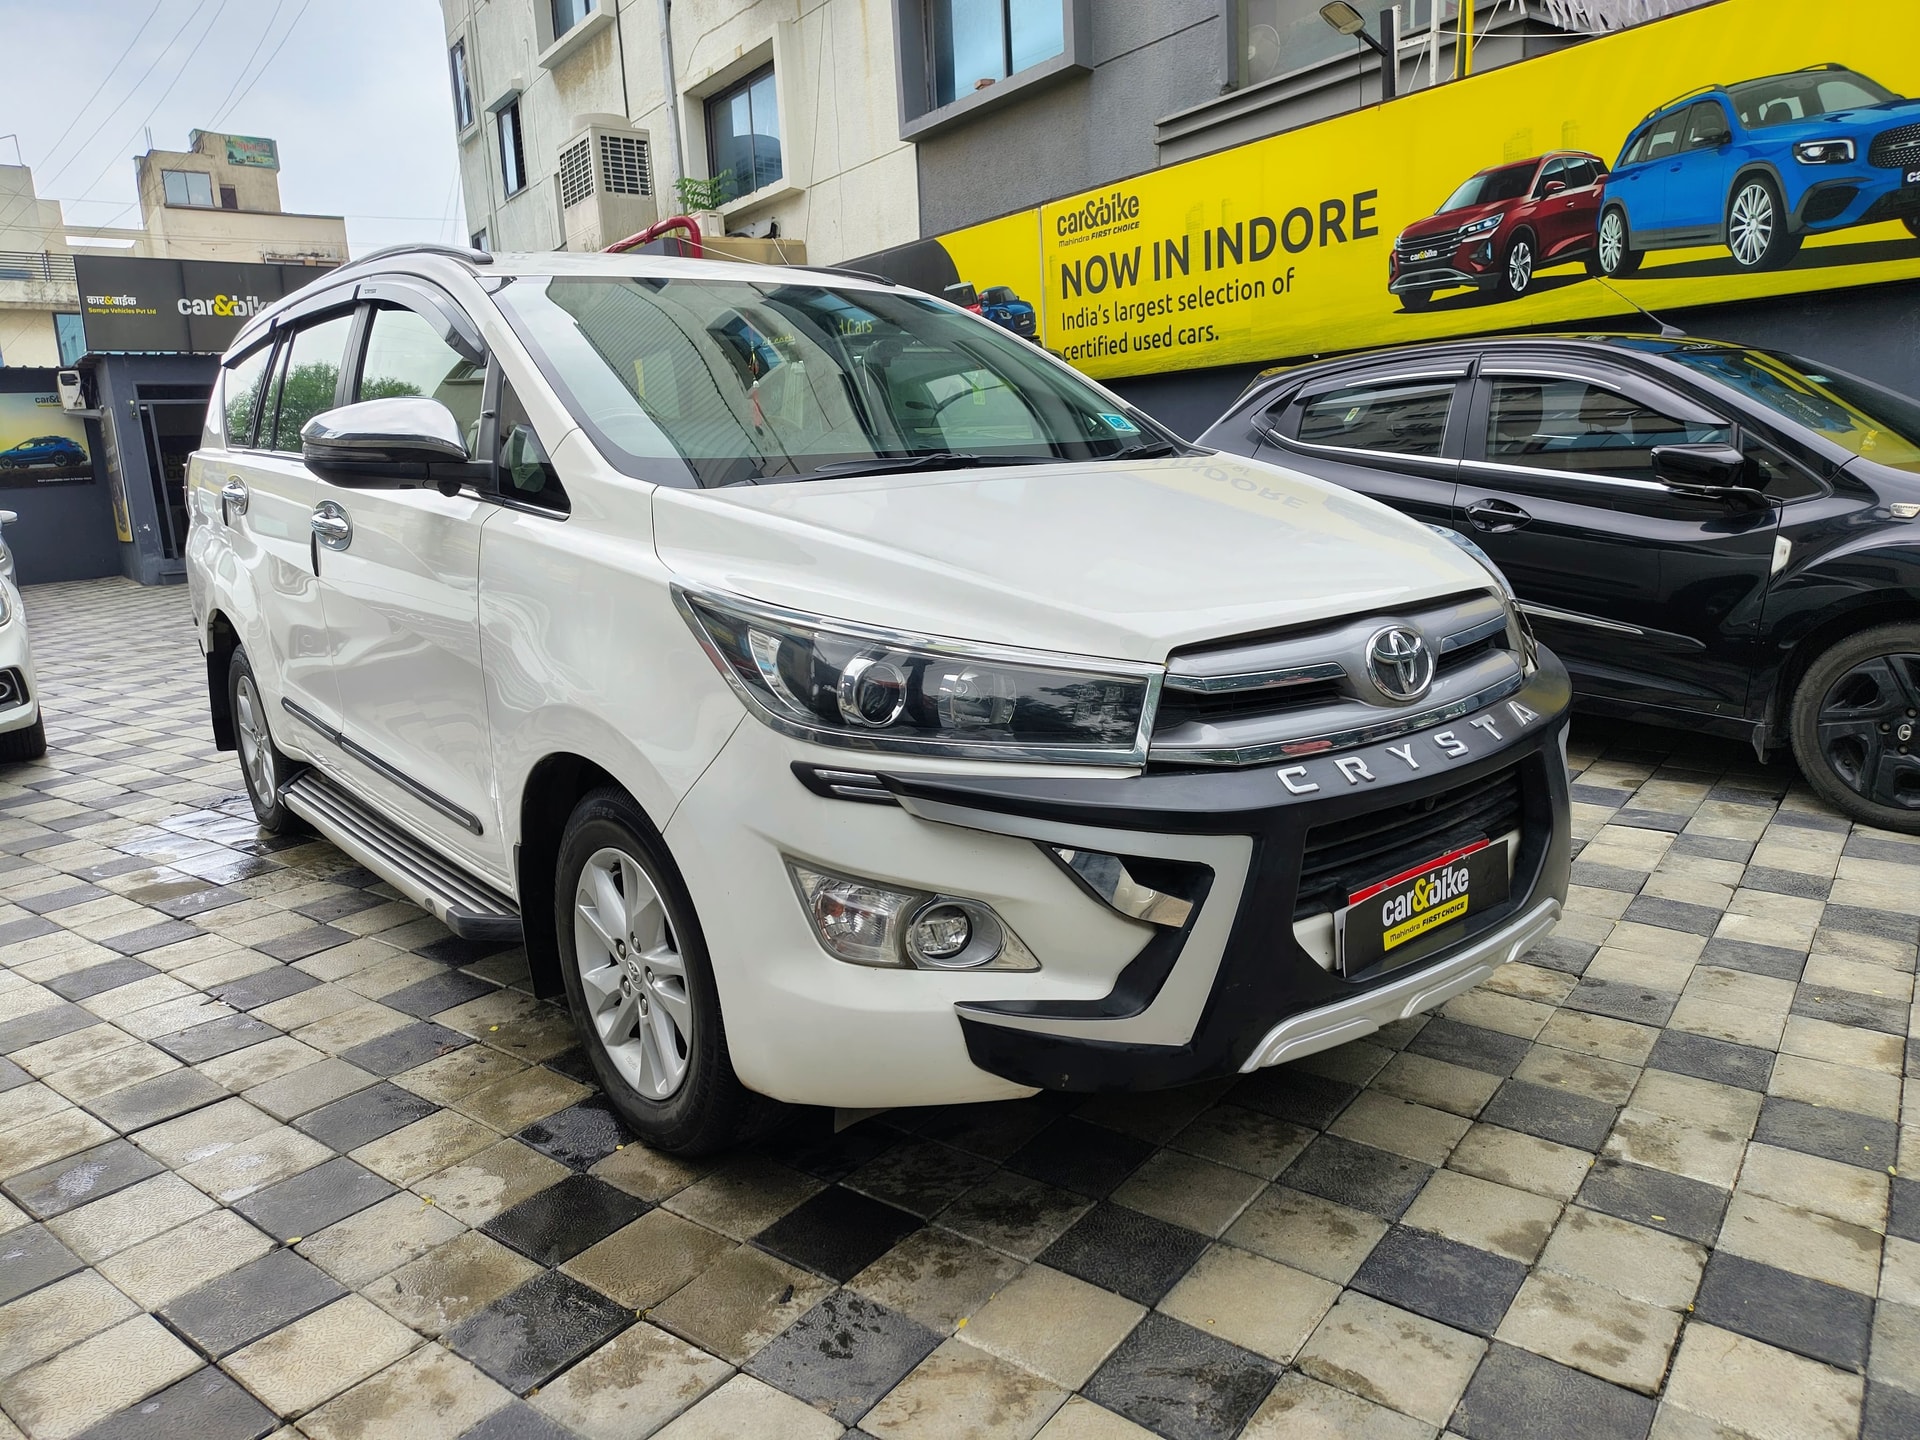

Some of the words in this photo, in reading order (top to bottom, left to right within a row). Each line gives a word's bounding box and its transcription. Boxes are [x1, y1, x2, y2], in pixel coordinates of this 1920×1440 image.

[1057, 192, 1139, 236] car&bike
[1058, 235, 1090, 248] Mahindra
[1091, 228, 1112, 240] FIRST
[1113, 221, 1140, 235] CHOICE
[1061, 246, 1142, 299] NOW
[1153, 235, 1190, 281] IN
[1204, 188, 1379, 272] INDORE
[1062, 304, 1110, 331] India's
[1114, 294, 1173, 323] largest
[1178, 278, 1265, 312] selection
[1272, 266, 1295, 295] of
[1063, 331, 1128, 361] certified
[1133, 324, 1172, 351] used
[1178, 325, 1219, 346] cars.
[1276, 700, 1540, 796] CRYSTA
[1382, 865, 1470, 927] car&bike
[1389, 923, 1421, 943] Mahindra
[1422, 912, 1441, 927] FIRST
[1441, 901, 1465, 918] CHOICE
